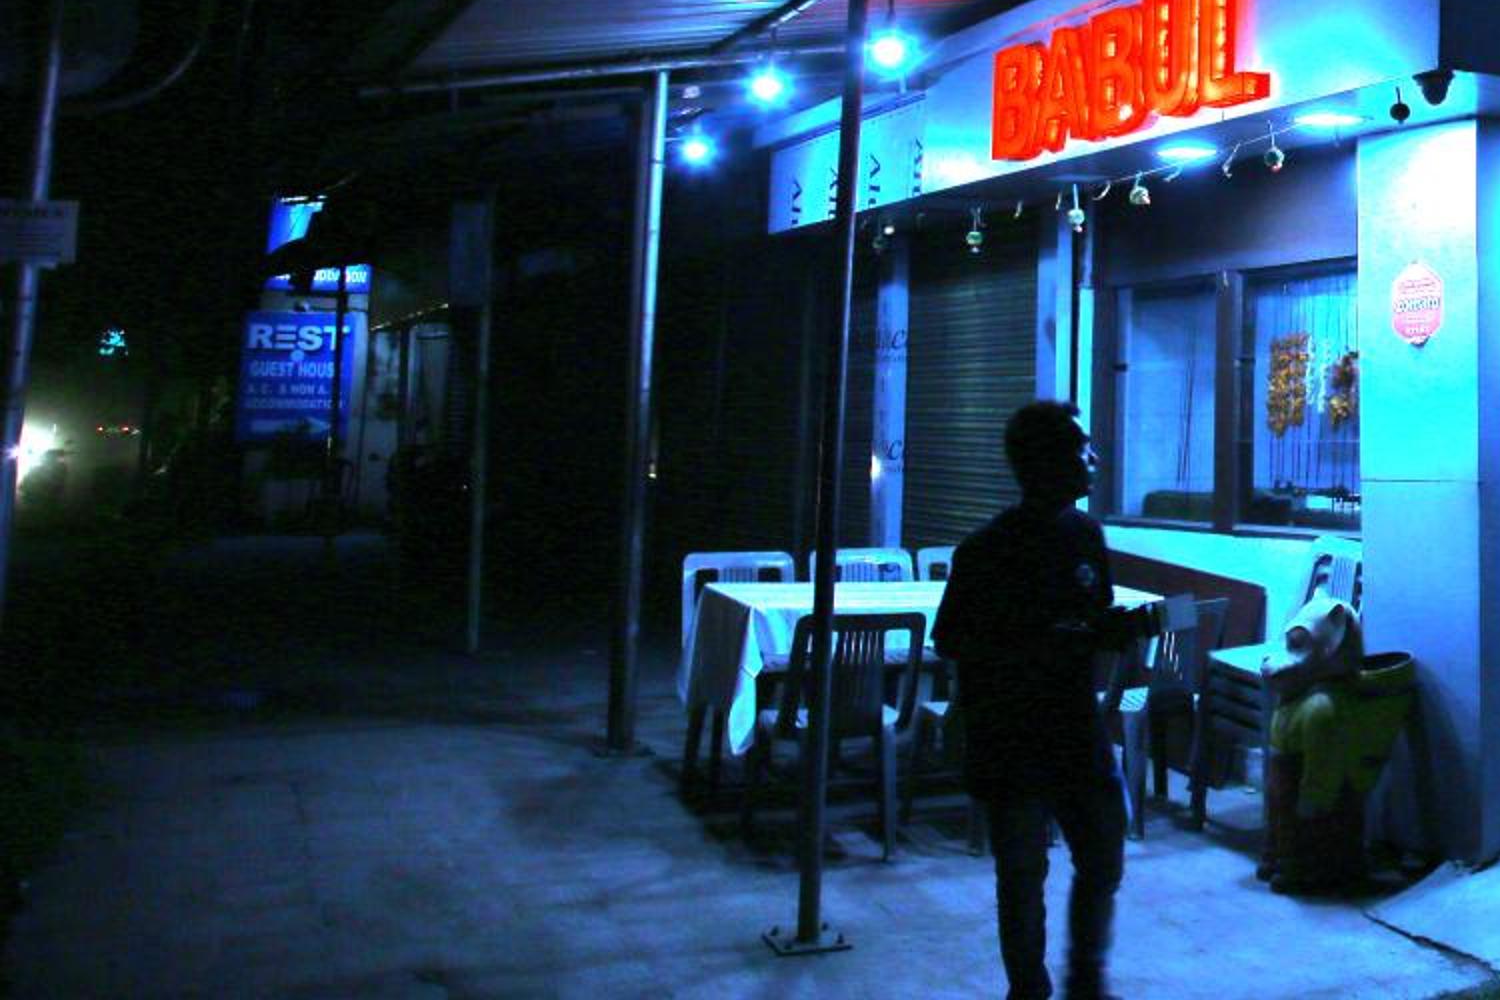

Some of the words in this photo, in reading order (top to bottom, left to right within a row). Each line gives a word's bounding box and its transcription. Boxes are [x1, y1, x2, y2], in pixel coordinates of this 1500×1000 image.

[249, 324, 351, 351] REST
[250, 360, 293, 377] GUEST
[297, 360, 336, 378] HOUS
